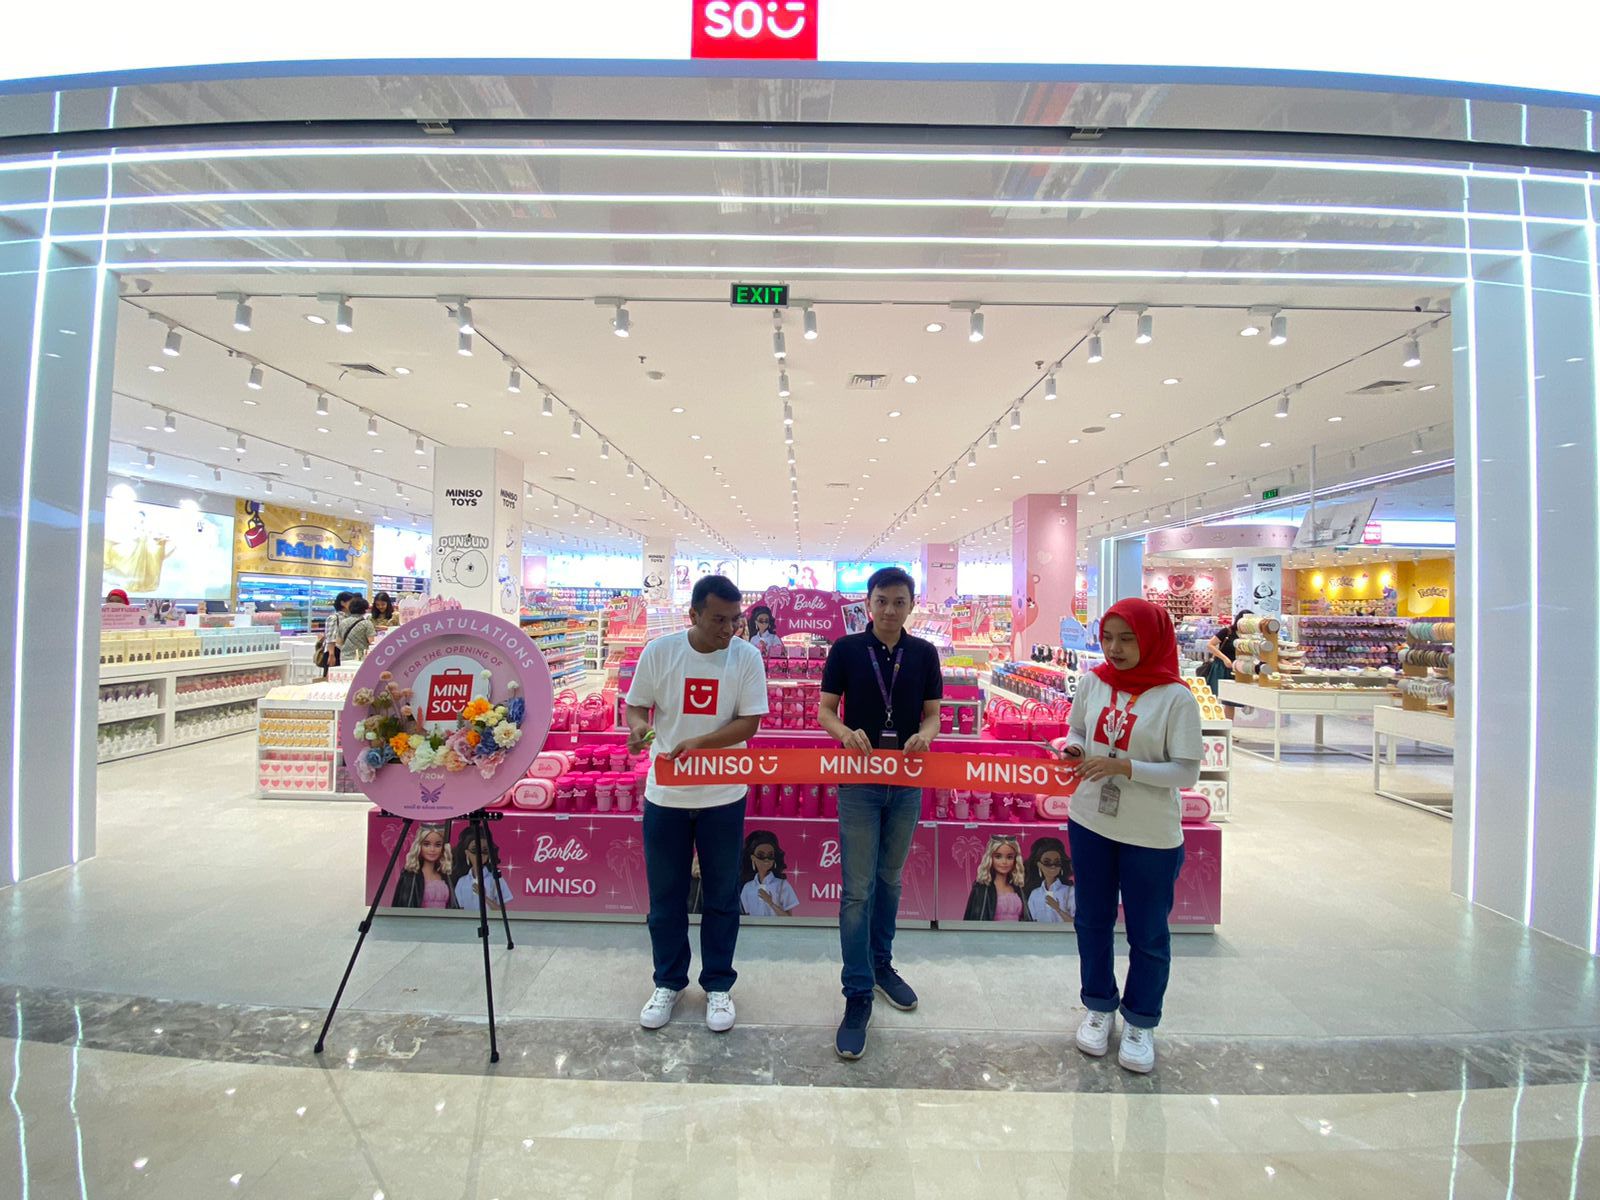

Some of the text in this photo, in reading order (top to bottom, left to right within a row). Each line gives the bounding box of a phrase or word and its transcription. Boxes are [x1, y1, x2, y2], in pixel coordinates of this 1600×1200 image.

[704, 0, 763, 38] SO
[737, 287, 783, 304] EXIT
[446, 489, 483, 498] MINISO
[500, 489, 518, 502] MINISO
[451, 498, 478, 507] TOYS
[503, 499, 516, 509] TOYS
[793, 593, 827, 611] Barbie
[788, 619, 832, 630] MINISO
[375, 618, 534, 669] CONGRATULATIONS
[404, 646, 504, 678] FOR THE OPENING OF
[434, 684, 468, 696] MINI
[674, 756, 753, 776] MINISO
[820, 755, 898, 776] MINISO
[966, 761, 1049, 785] MINISO
[534, 835, 588, 863] Barbie
[525, 878, 596, 895] MINISO
